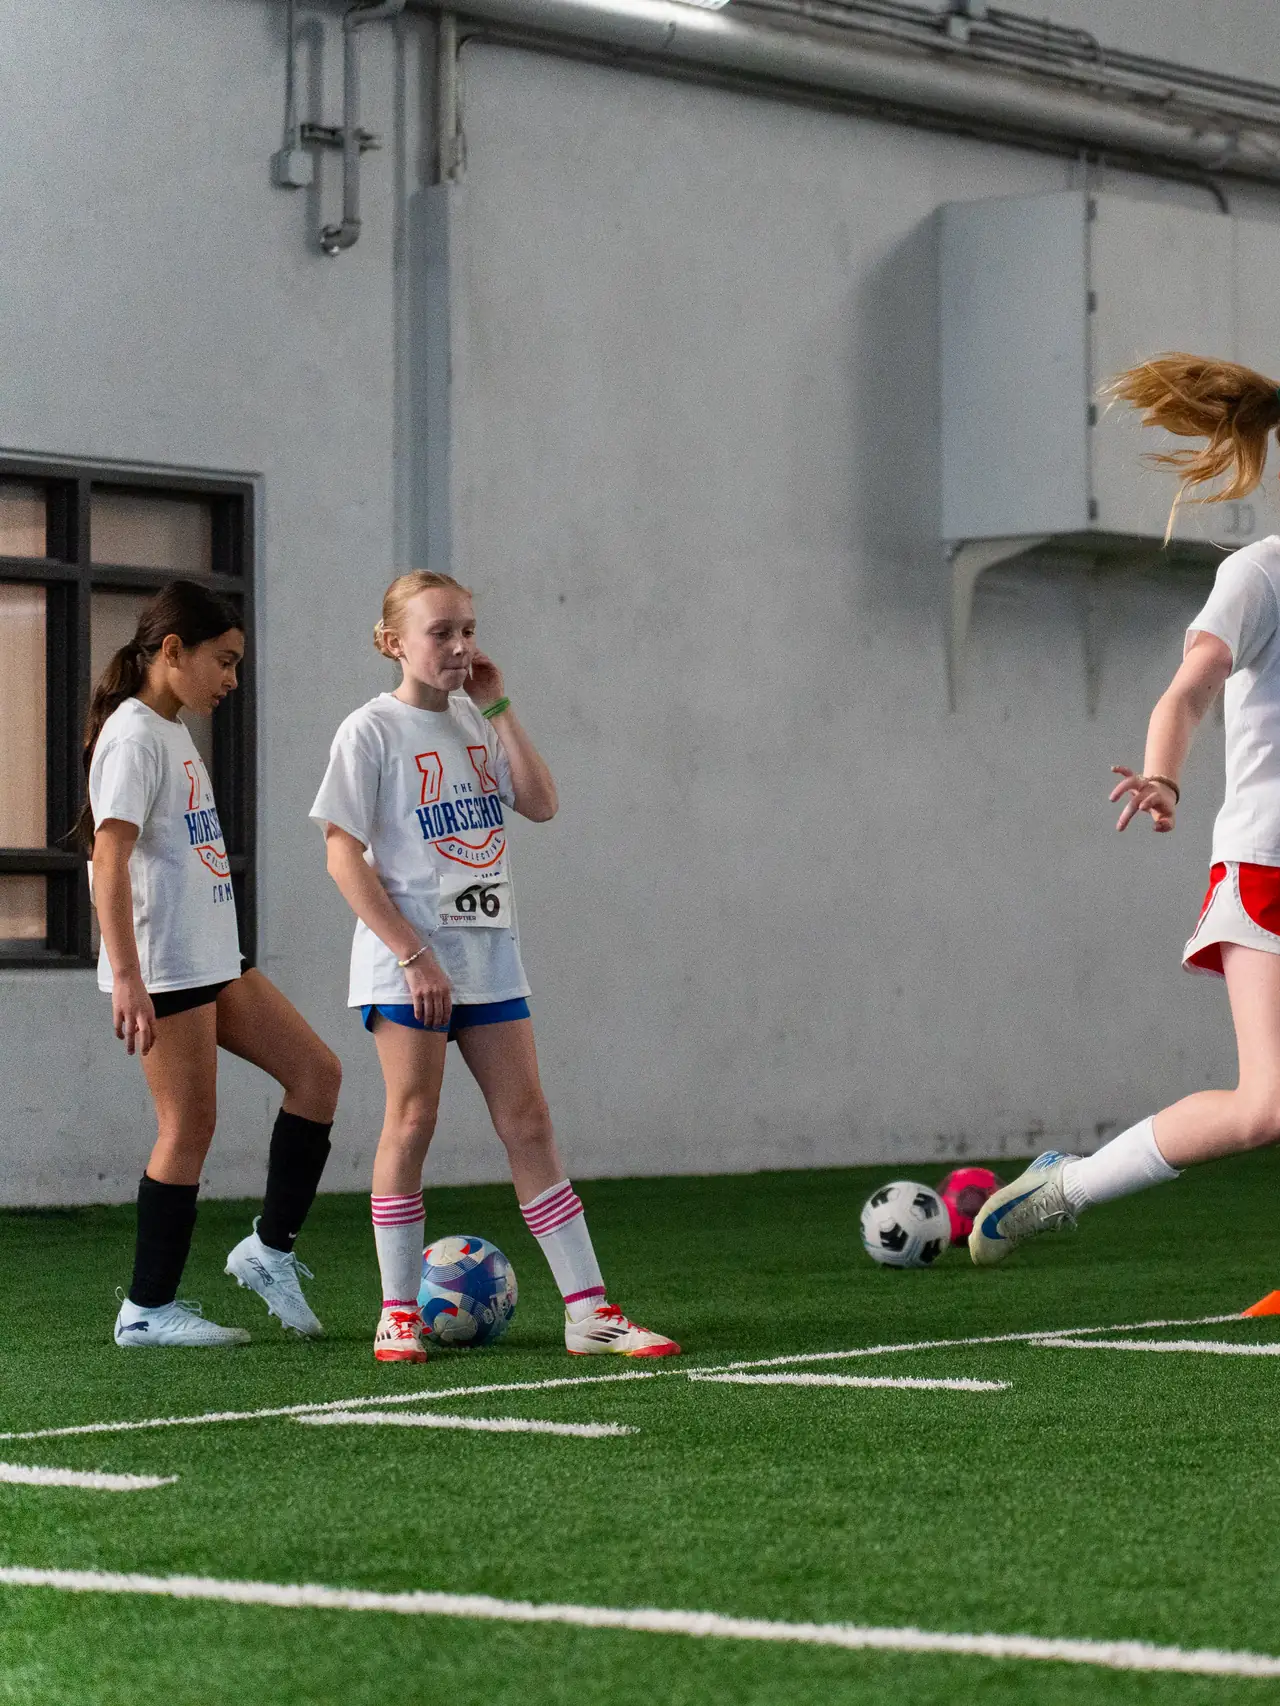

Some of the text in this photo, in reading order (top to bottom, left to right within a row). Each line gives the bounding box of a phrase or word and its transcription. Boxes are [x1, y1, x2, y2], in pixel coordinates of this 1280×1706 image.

[453, 782, 473, 795] THE
[415, 794, 504, 840] HORSESHO
[455, 882, 501, 918] 66
